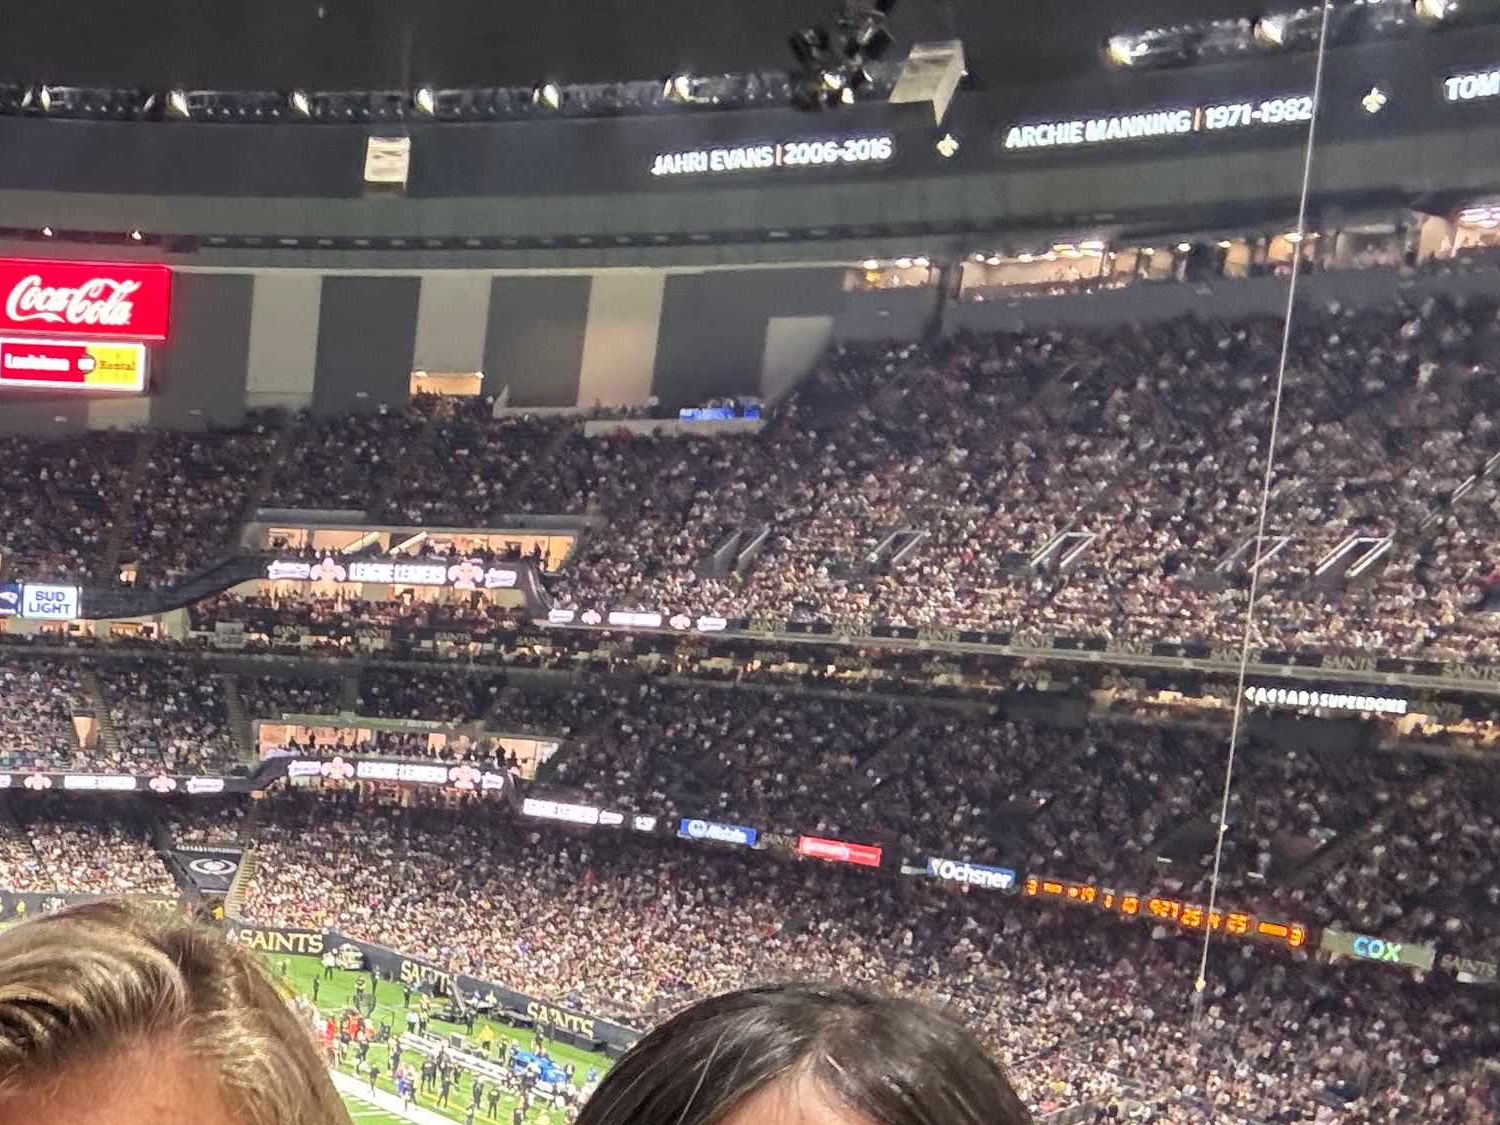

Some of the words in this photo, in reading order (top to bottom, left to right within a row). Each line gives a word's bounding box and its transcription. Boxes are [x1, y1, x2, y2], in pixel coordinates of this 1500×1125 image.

[1005, 122, 1083, 148] ARCHIE
[1085, 110, 1191, 142] MANNING
[1205, 97, 1312, 130] 1971-1982
[651, 151, 708, 176] JAHRI
[710, 146, 774, 172] EVANS
[784, 137, 892, 165] 2006-2016
[29, 601, 71, 615] LIGHT
[35, 590, 65, 602] BUD
[940, 860, 1012, 889] Ochsner
[239, 928, 324, 953] SAINTS
